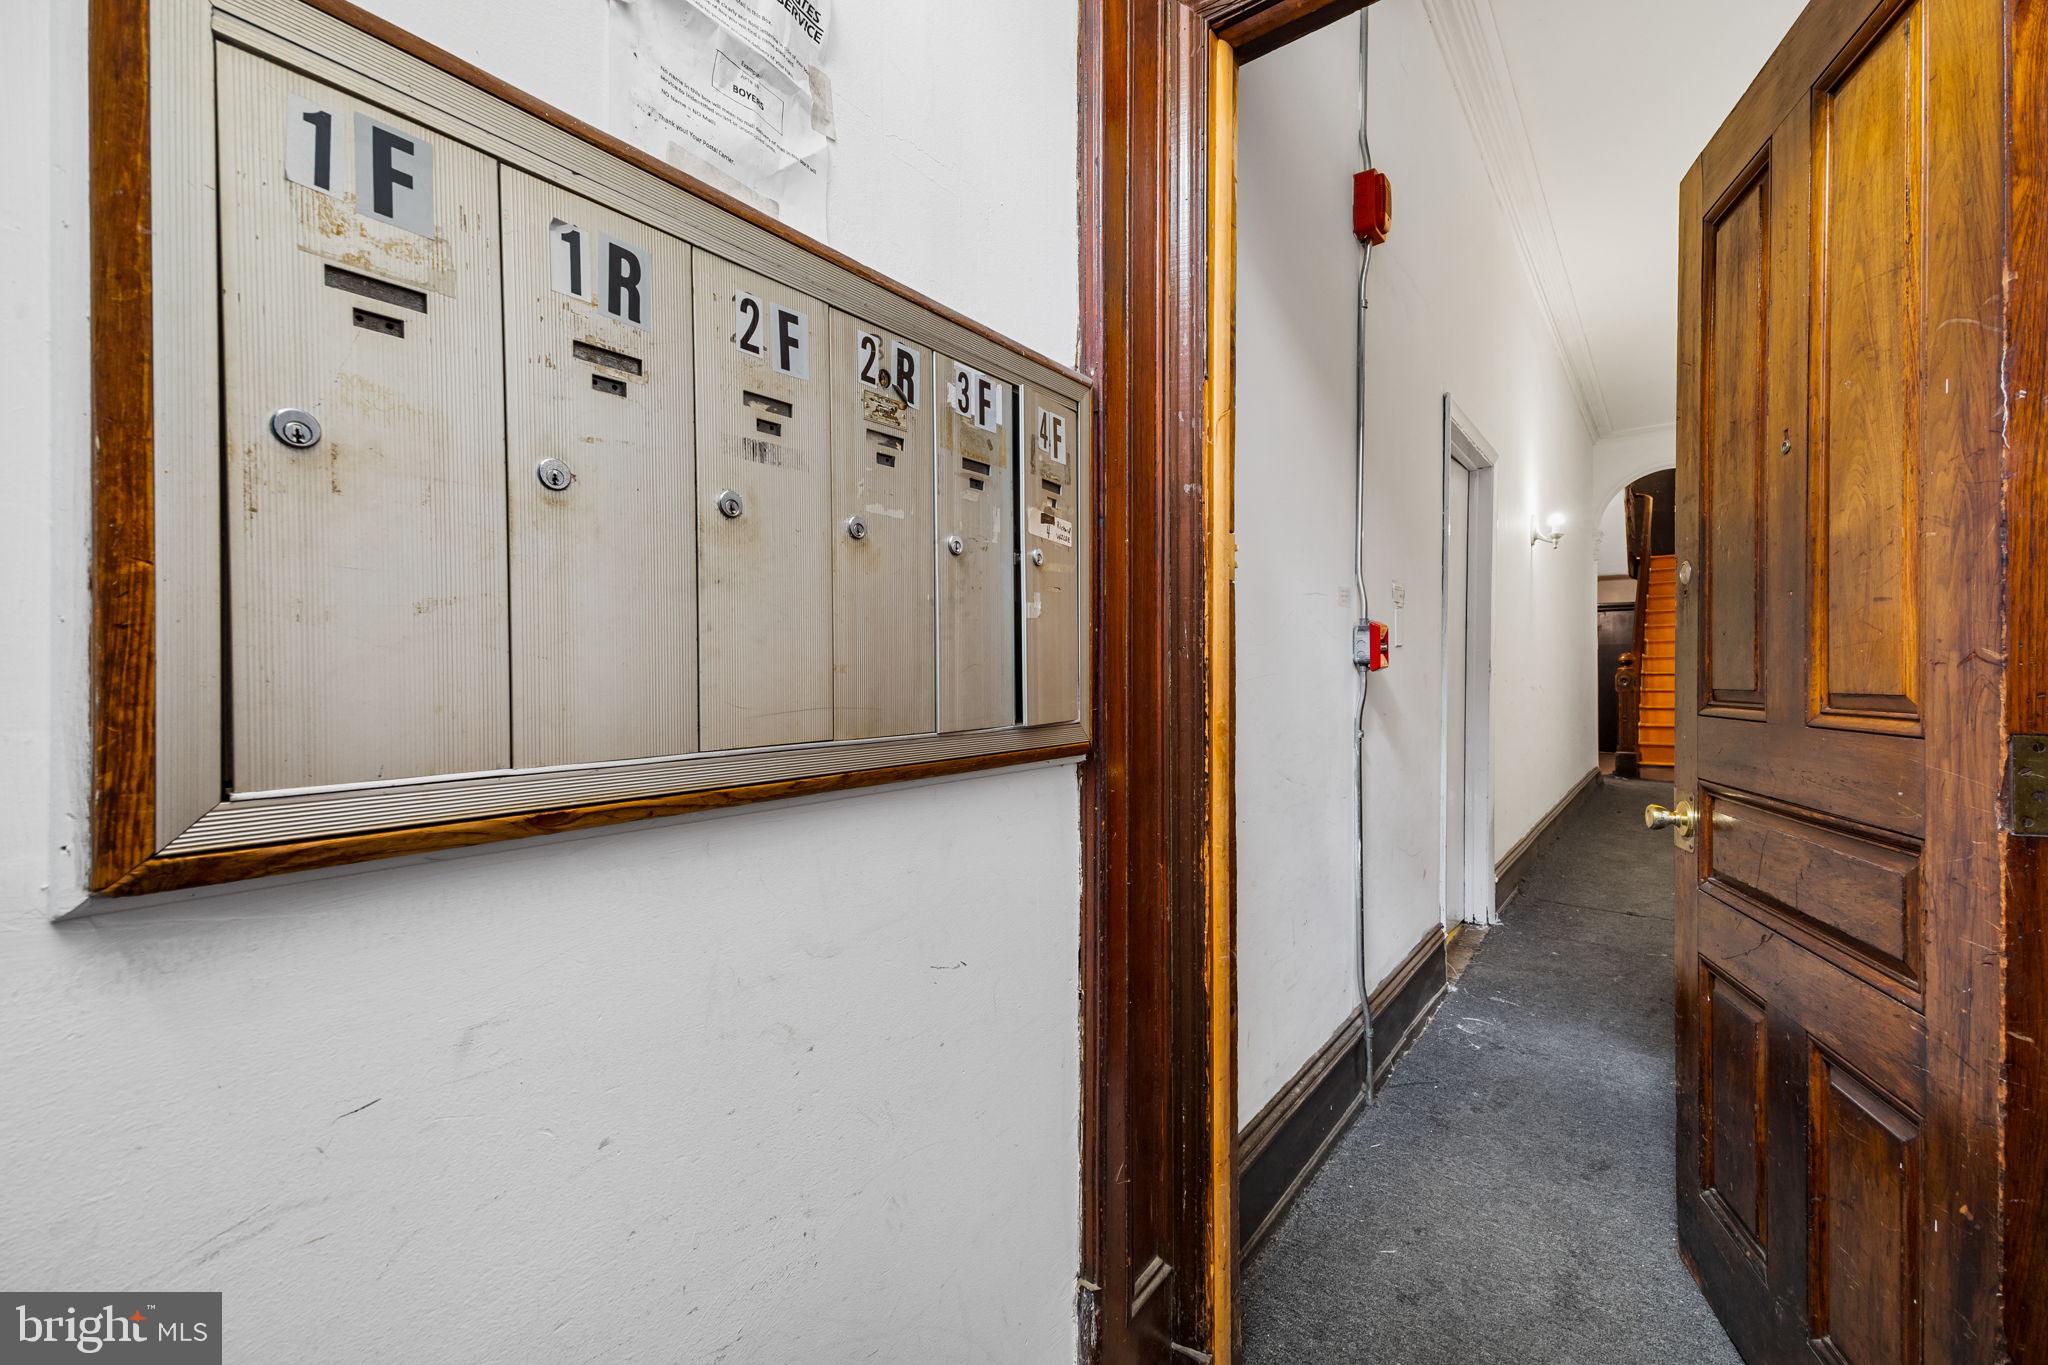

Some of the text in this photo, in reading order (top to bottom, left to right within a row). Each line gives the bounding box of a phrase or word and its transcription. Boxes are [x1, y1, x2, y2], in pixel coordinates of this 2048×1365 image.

[660, 74, 678, 90] service
[669, 71, 683, 86] name
[684, 82, 690, 90] in
[690, 87, 701, 98] this
[701, 93, 711, 104] box
[670, 95, 687, 109] Name
[692, 108, 702, 118] NO
[732, 84, 764, 111] BOYERS
[658, 112, 676, 128] Thank
[689, 131, 702, 144] Your
[702, 139, 718, 154] Postal
